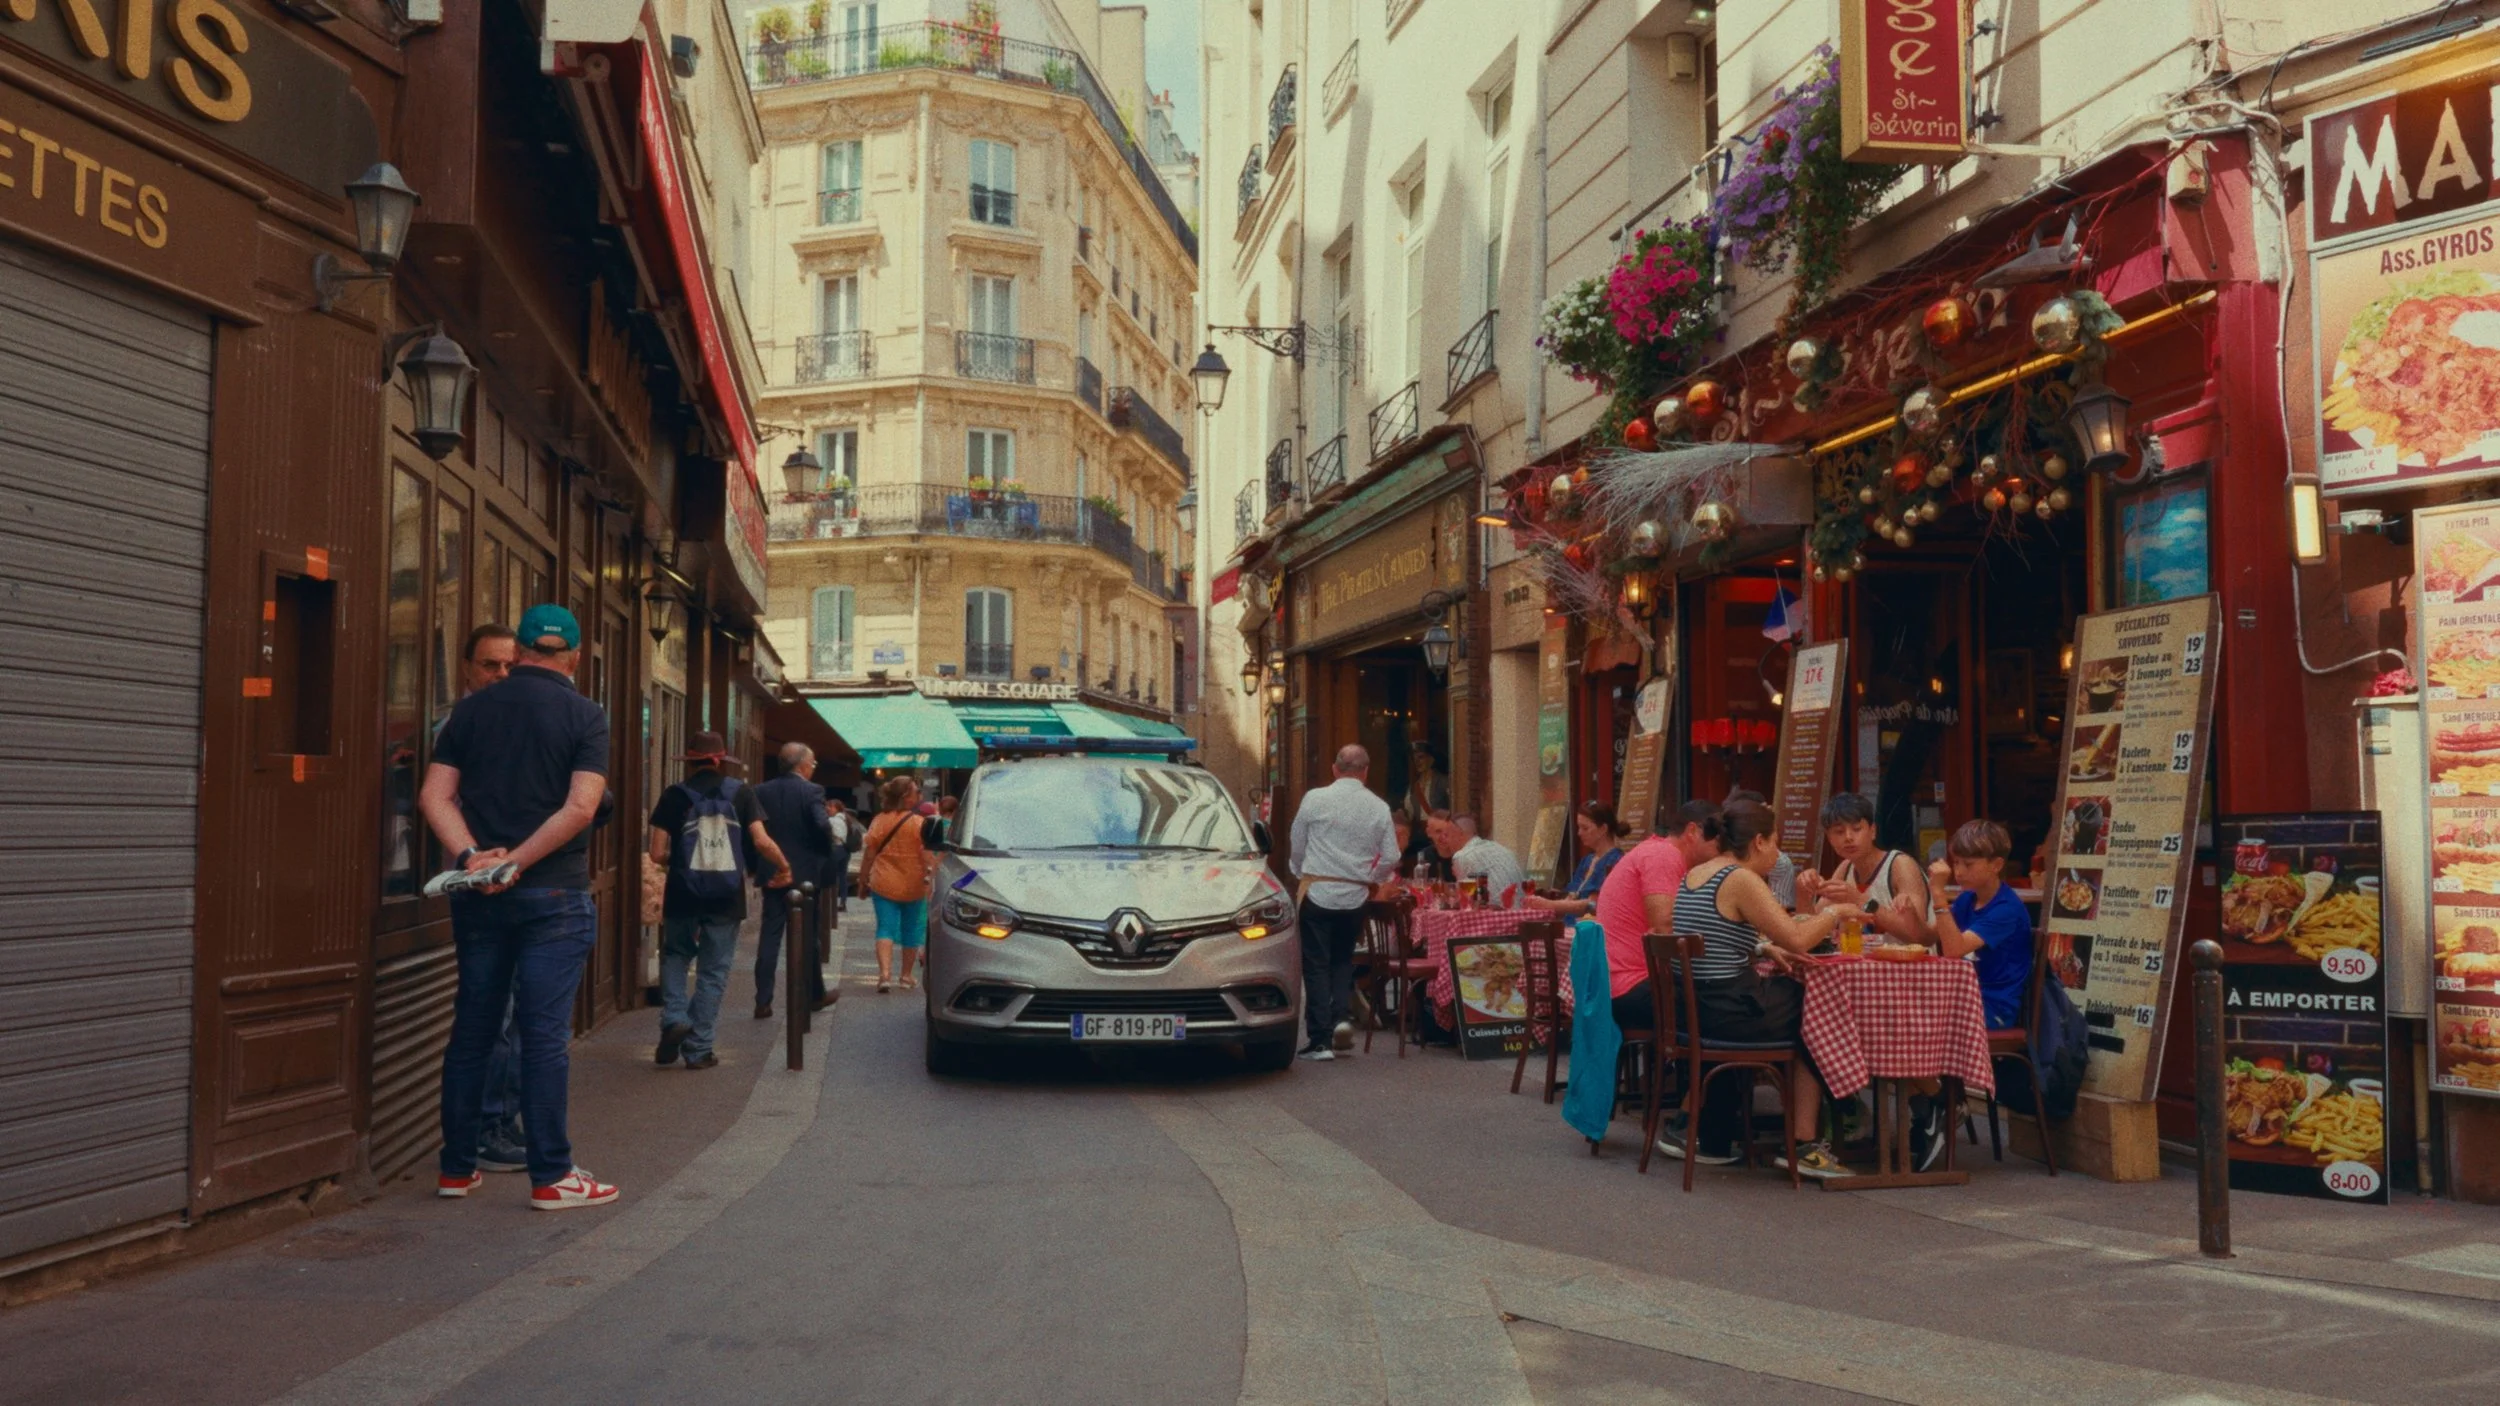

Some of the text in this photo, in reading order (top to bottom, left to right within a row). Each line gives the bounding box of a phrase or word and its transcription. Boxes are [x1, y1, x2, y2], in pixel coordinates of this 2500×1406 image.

[1869, 112, 1957, 137] Séverin
[2330, 84, 2500, 223] MA
[2439, 616, 2457, 627] PAIN
[923, 679, 1079, 701] UNION SQUARE
[2129, 937, 2139, 948] de
[2327, 956, 2366, 976] 9.50
[2227, 988, 2376, 1011] À EMPORTER
[1085, 1018, 1173, 1036] GF-819-PD
[1468, 1028, 1500, 1038] Cuisses
[1502, 1025, 1512, 1035] de
[2330, 1171, 2371, 1192] 8.00
